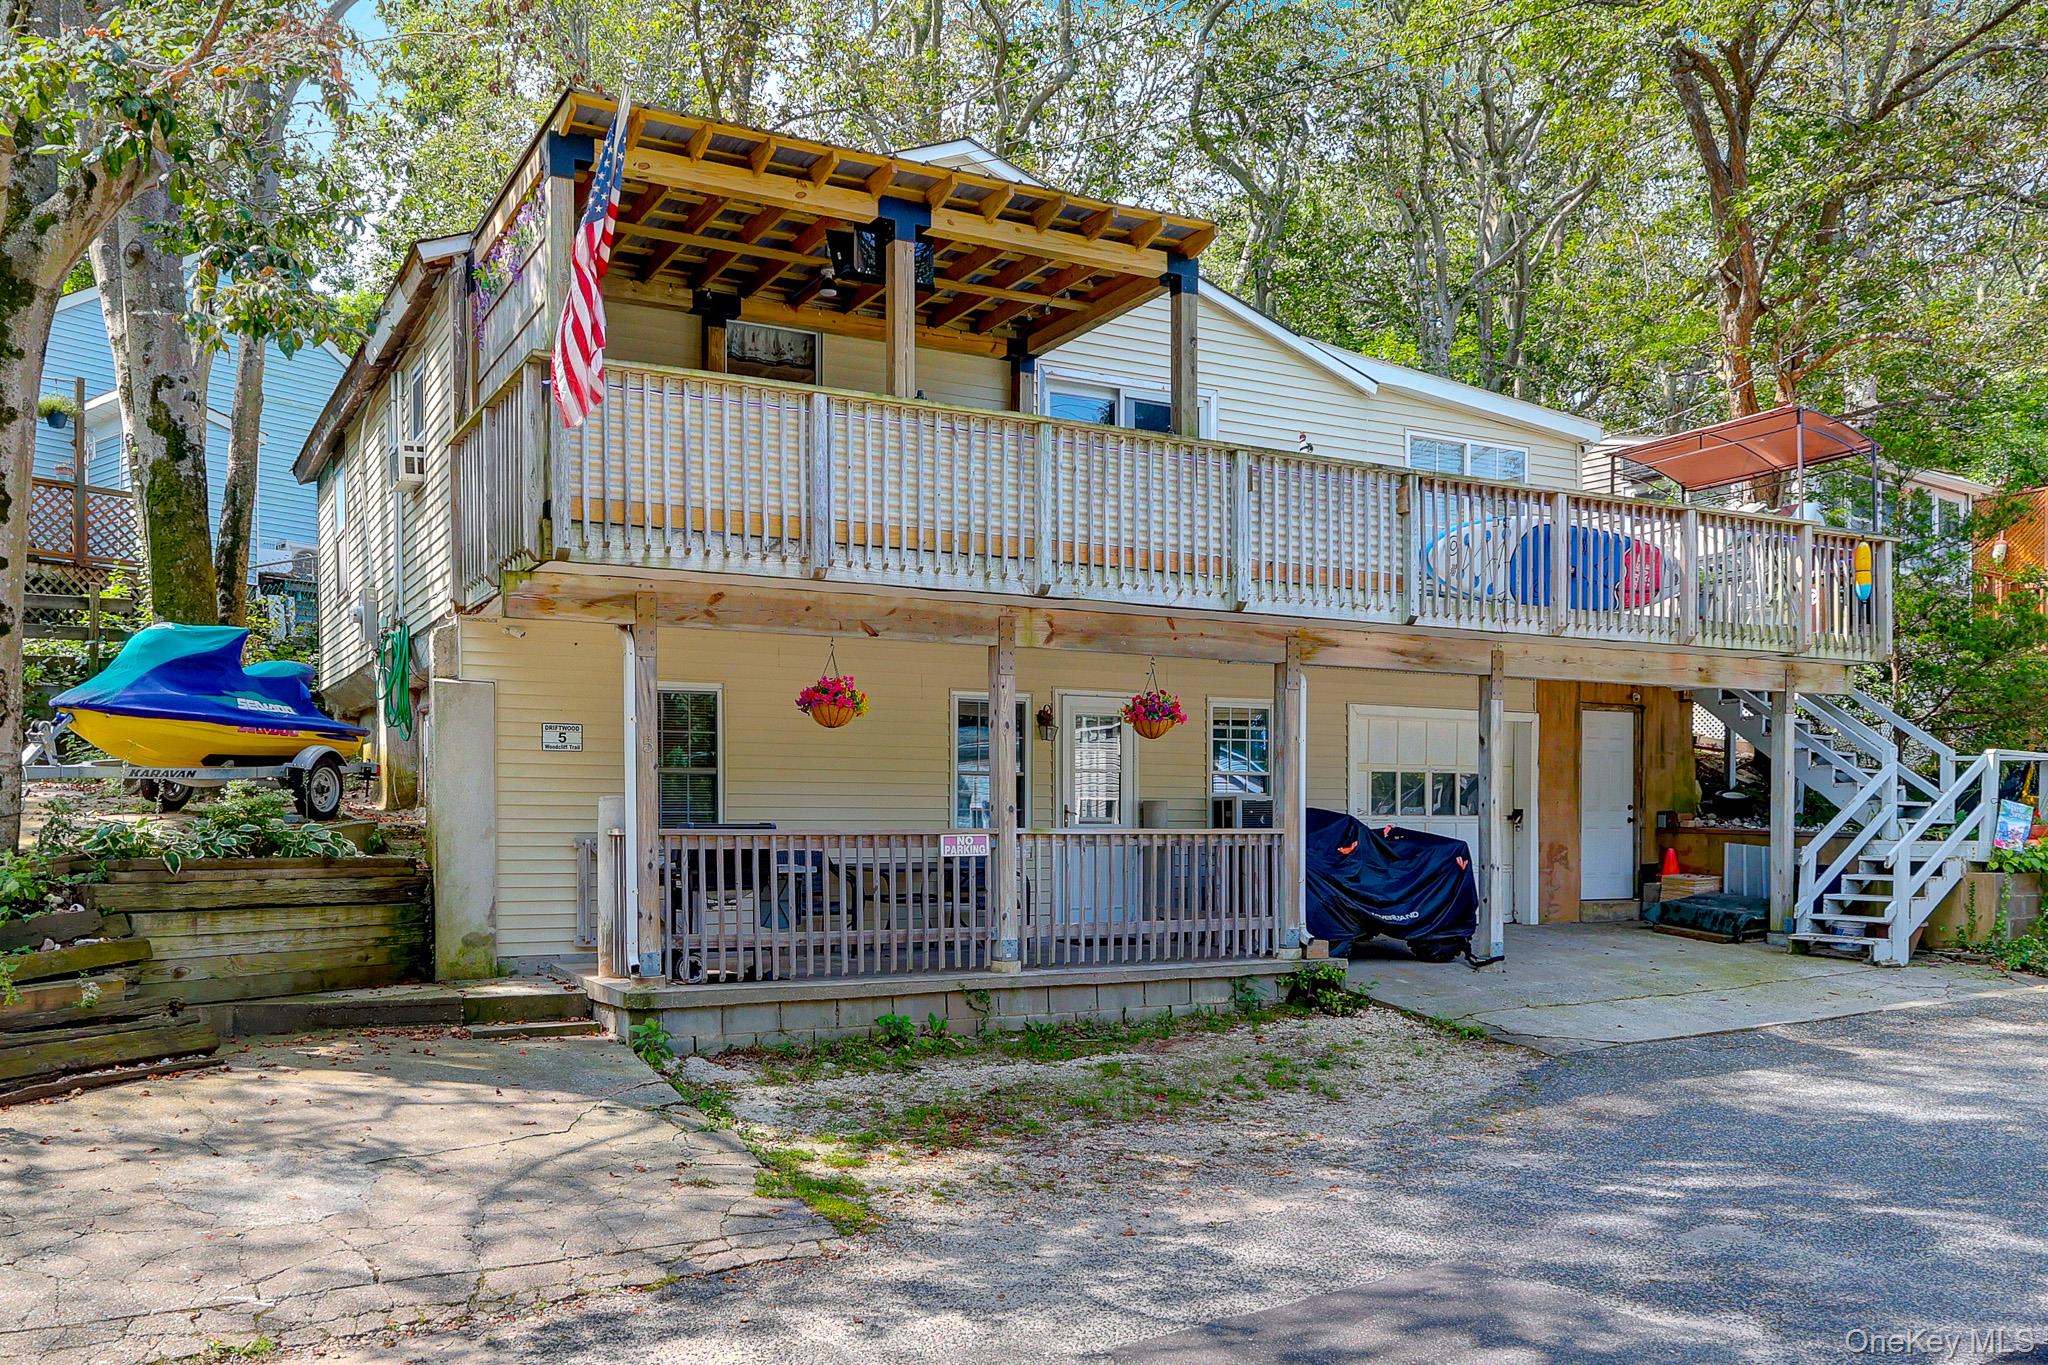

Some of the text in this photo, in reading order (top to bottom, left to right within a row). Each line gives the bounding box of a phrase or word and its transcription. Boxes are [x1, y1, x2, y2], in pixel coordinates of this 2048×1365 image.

[558, 732, 567, 743] 5
[128, 768, 197, 778] KARAVAN
[956, 836, 974, 845] NO
[944, 845, 986, 855] PARKING
